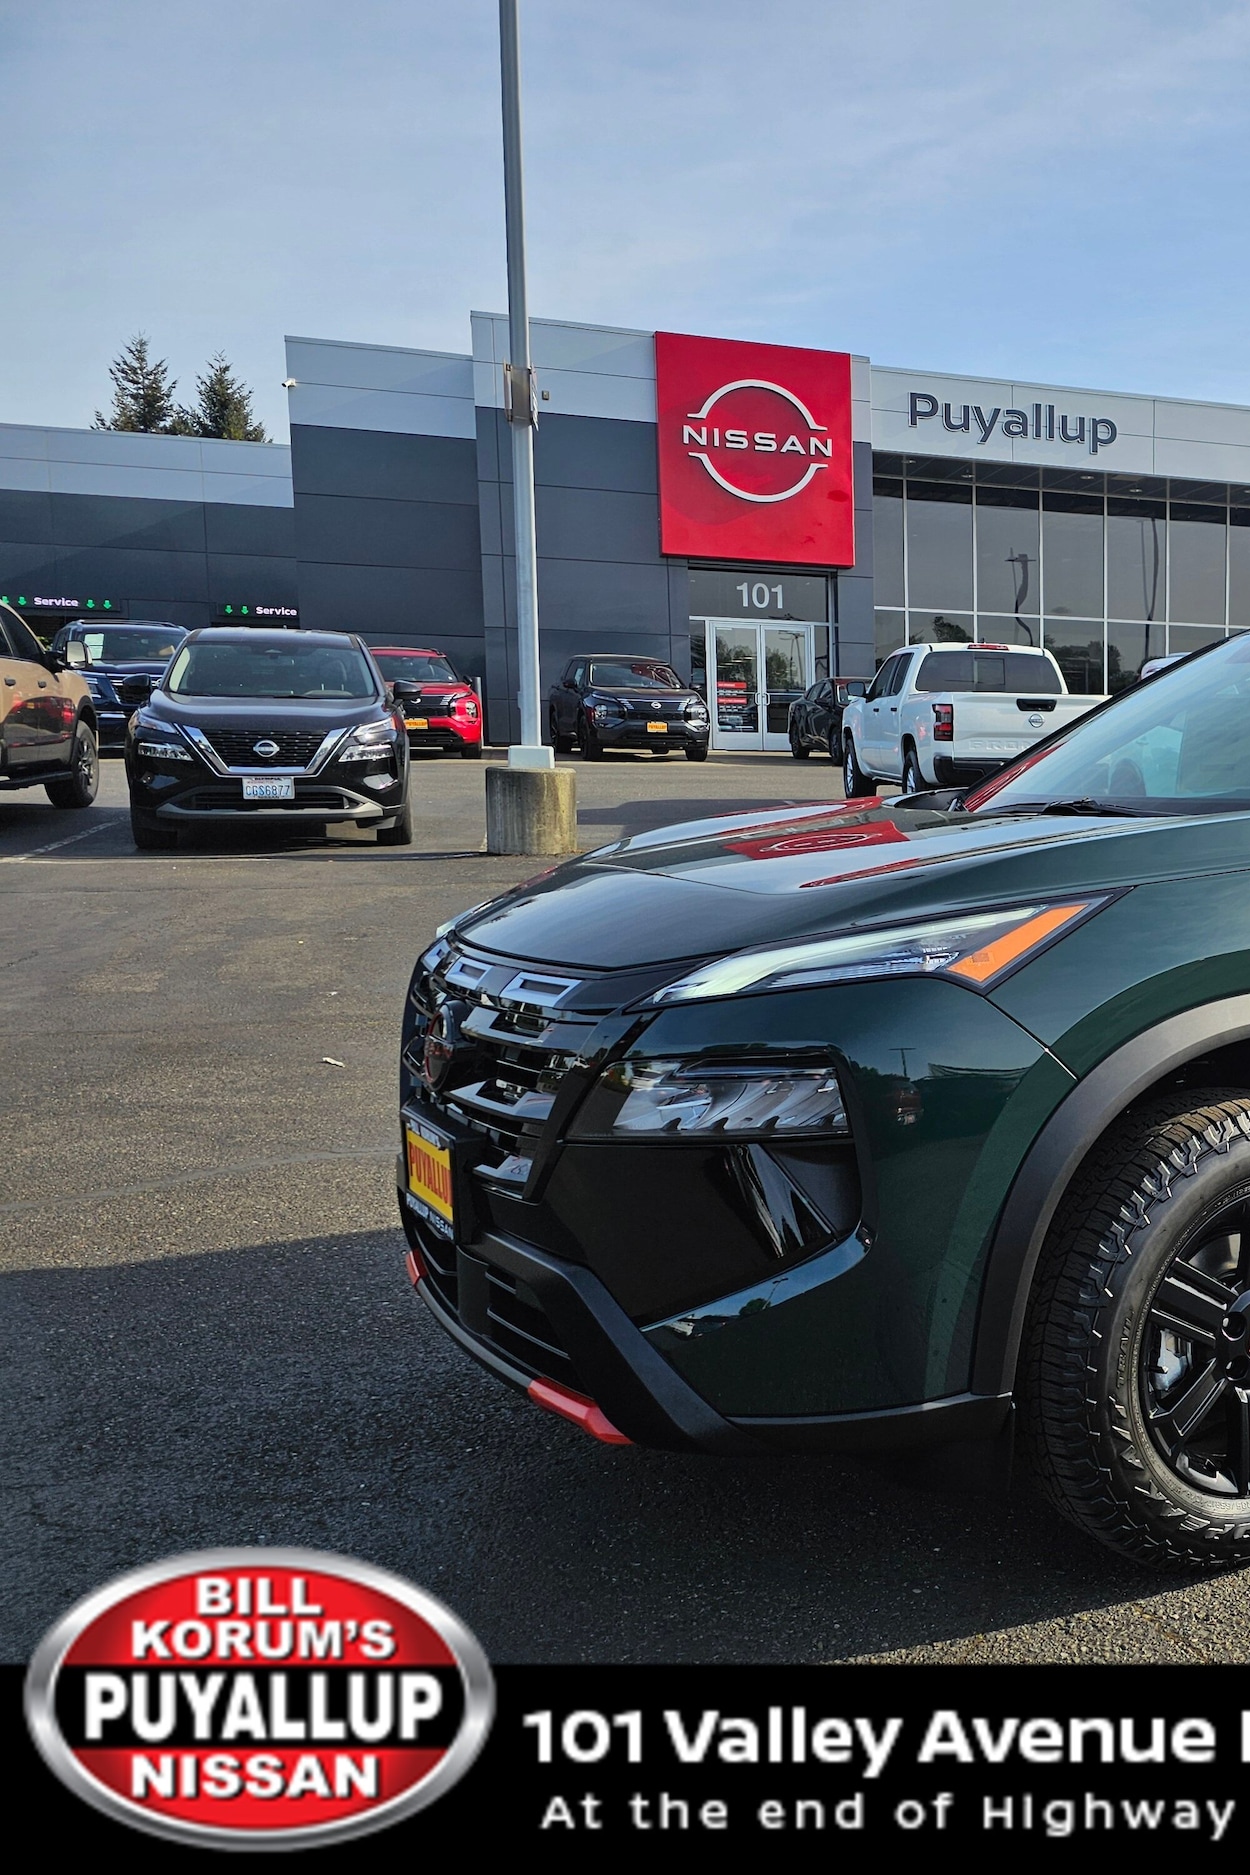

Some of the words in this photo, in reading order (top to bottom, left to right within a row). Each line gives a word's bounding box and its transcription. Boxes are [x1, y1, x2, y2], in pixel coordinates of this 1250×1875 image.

[908, 392, 1118, 454] Puyallup
[683, 425, 833, 457] NISSAN
[33, 597, 79, 607] Service
[736, 582, 783, 609] 101
[255, 606, 297, 616] Service
[246, 785, 290, 796] CGS6877
